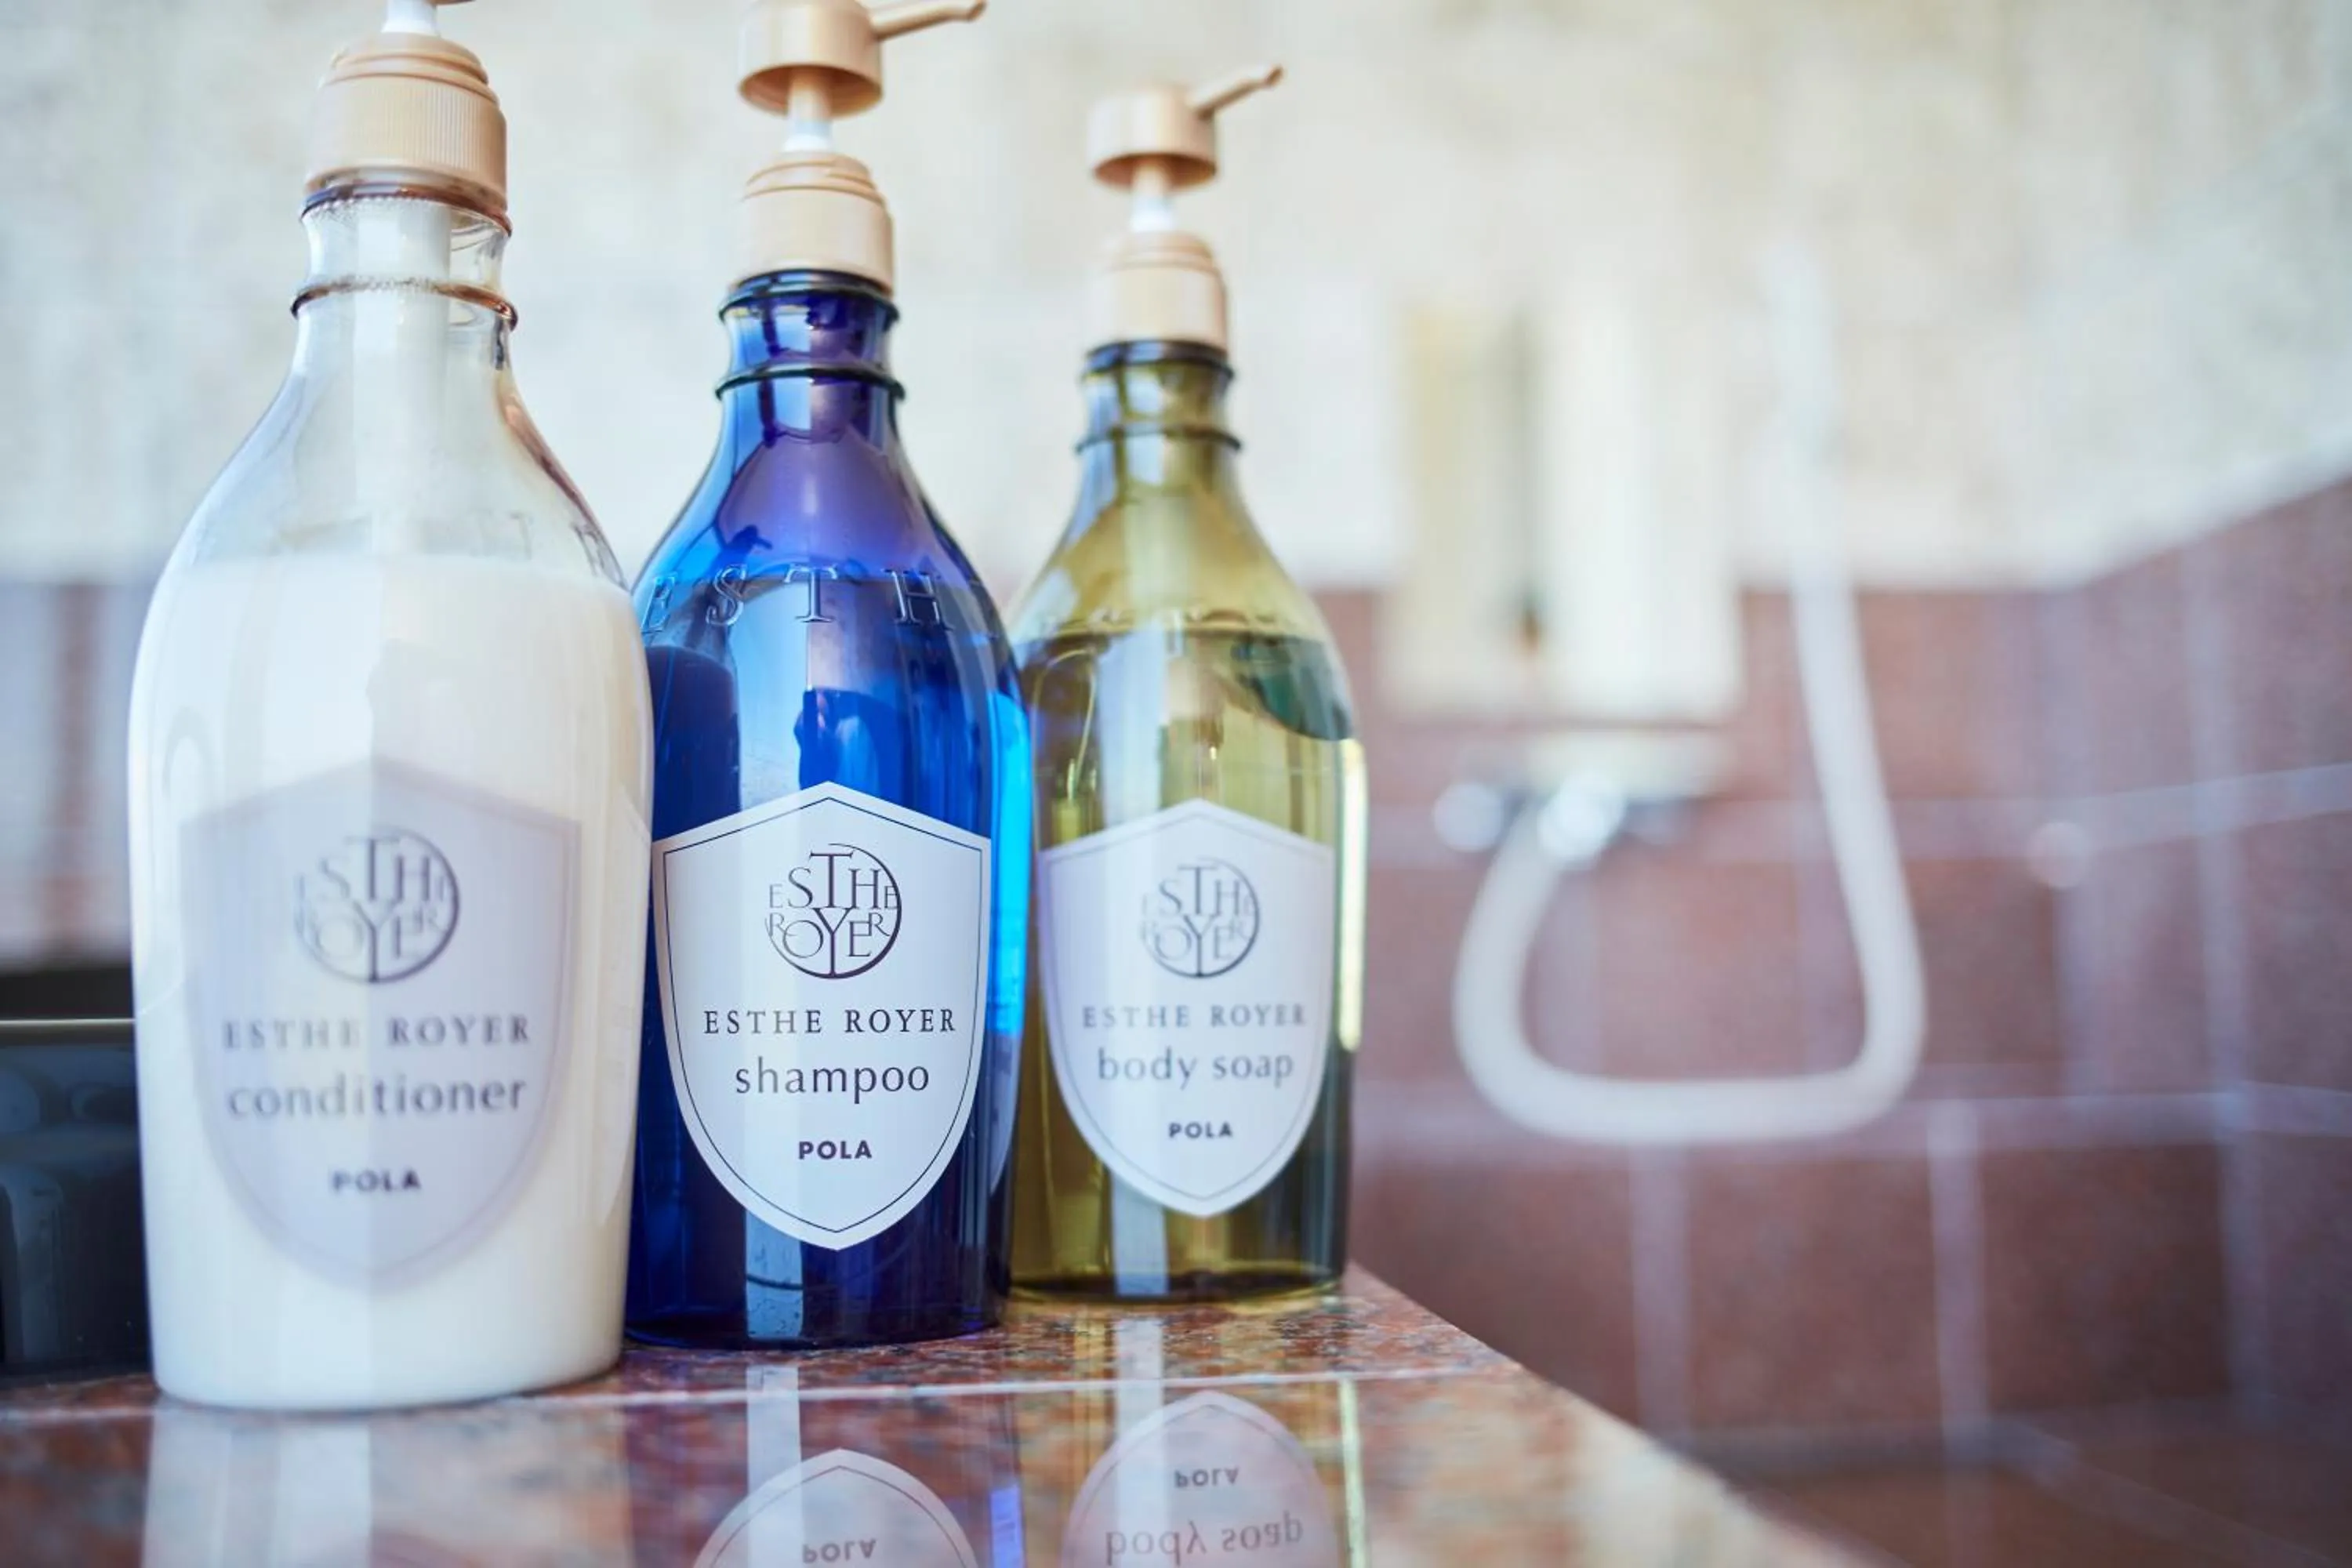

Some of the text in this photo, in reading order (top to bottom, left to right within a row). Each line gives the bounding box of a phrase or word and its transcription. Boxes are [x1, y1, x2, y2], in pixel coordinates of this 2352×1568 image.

[768, 851, 901, 909] ESTHE
[768, 907, 891, 978] ROYER
[223, 1014, 531, 1051] ESTHE ROYER
[704, 1008, 956, 1034] ESTHE ROYER
[1083, 1002, 1307, 1029] ESTHE ROYER
[735, 1057, 930, 1105] shampoo
[1098, 1047, 1294, 1091] body soap
[227, 1073, 528, 1120] conditioner
[1168, 1122, 1233, 1139] POLA
[798, 1140, 873, 1160] POLA
[332, 1170, 422, 1193] POLA
